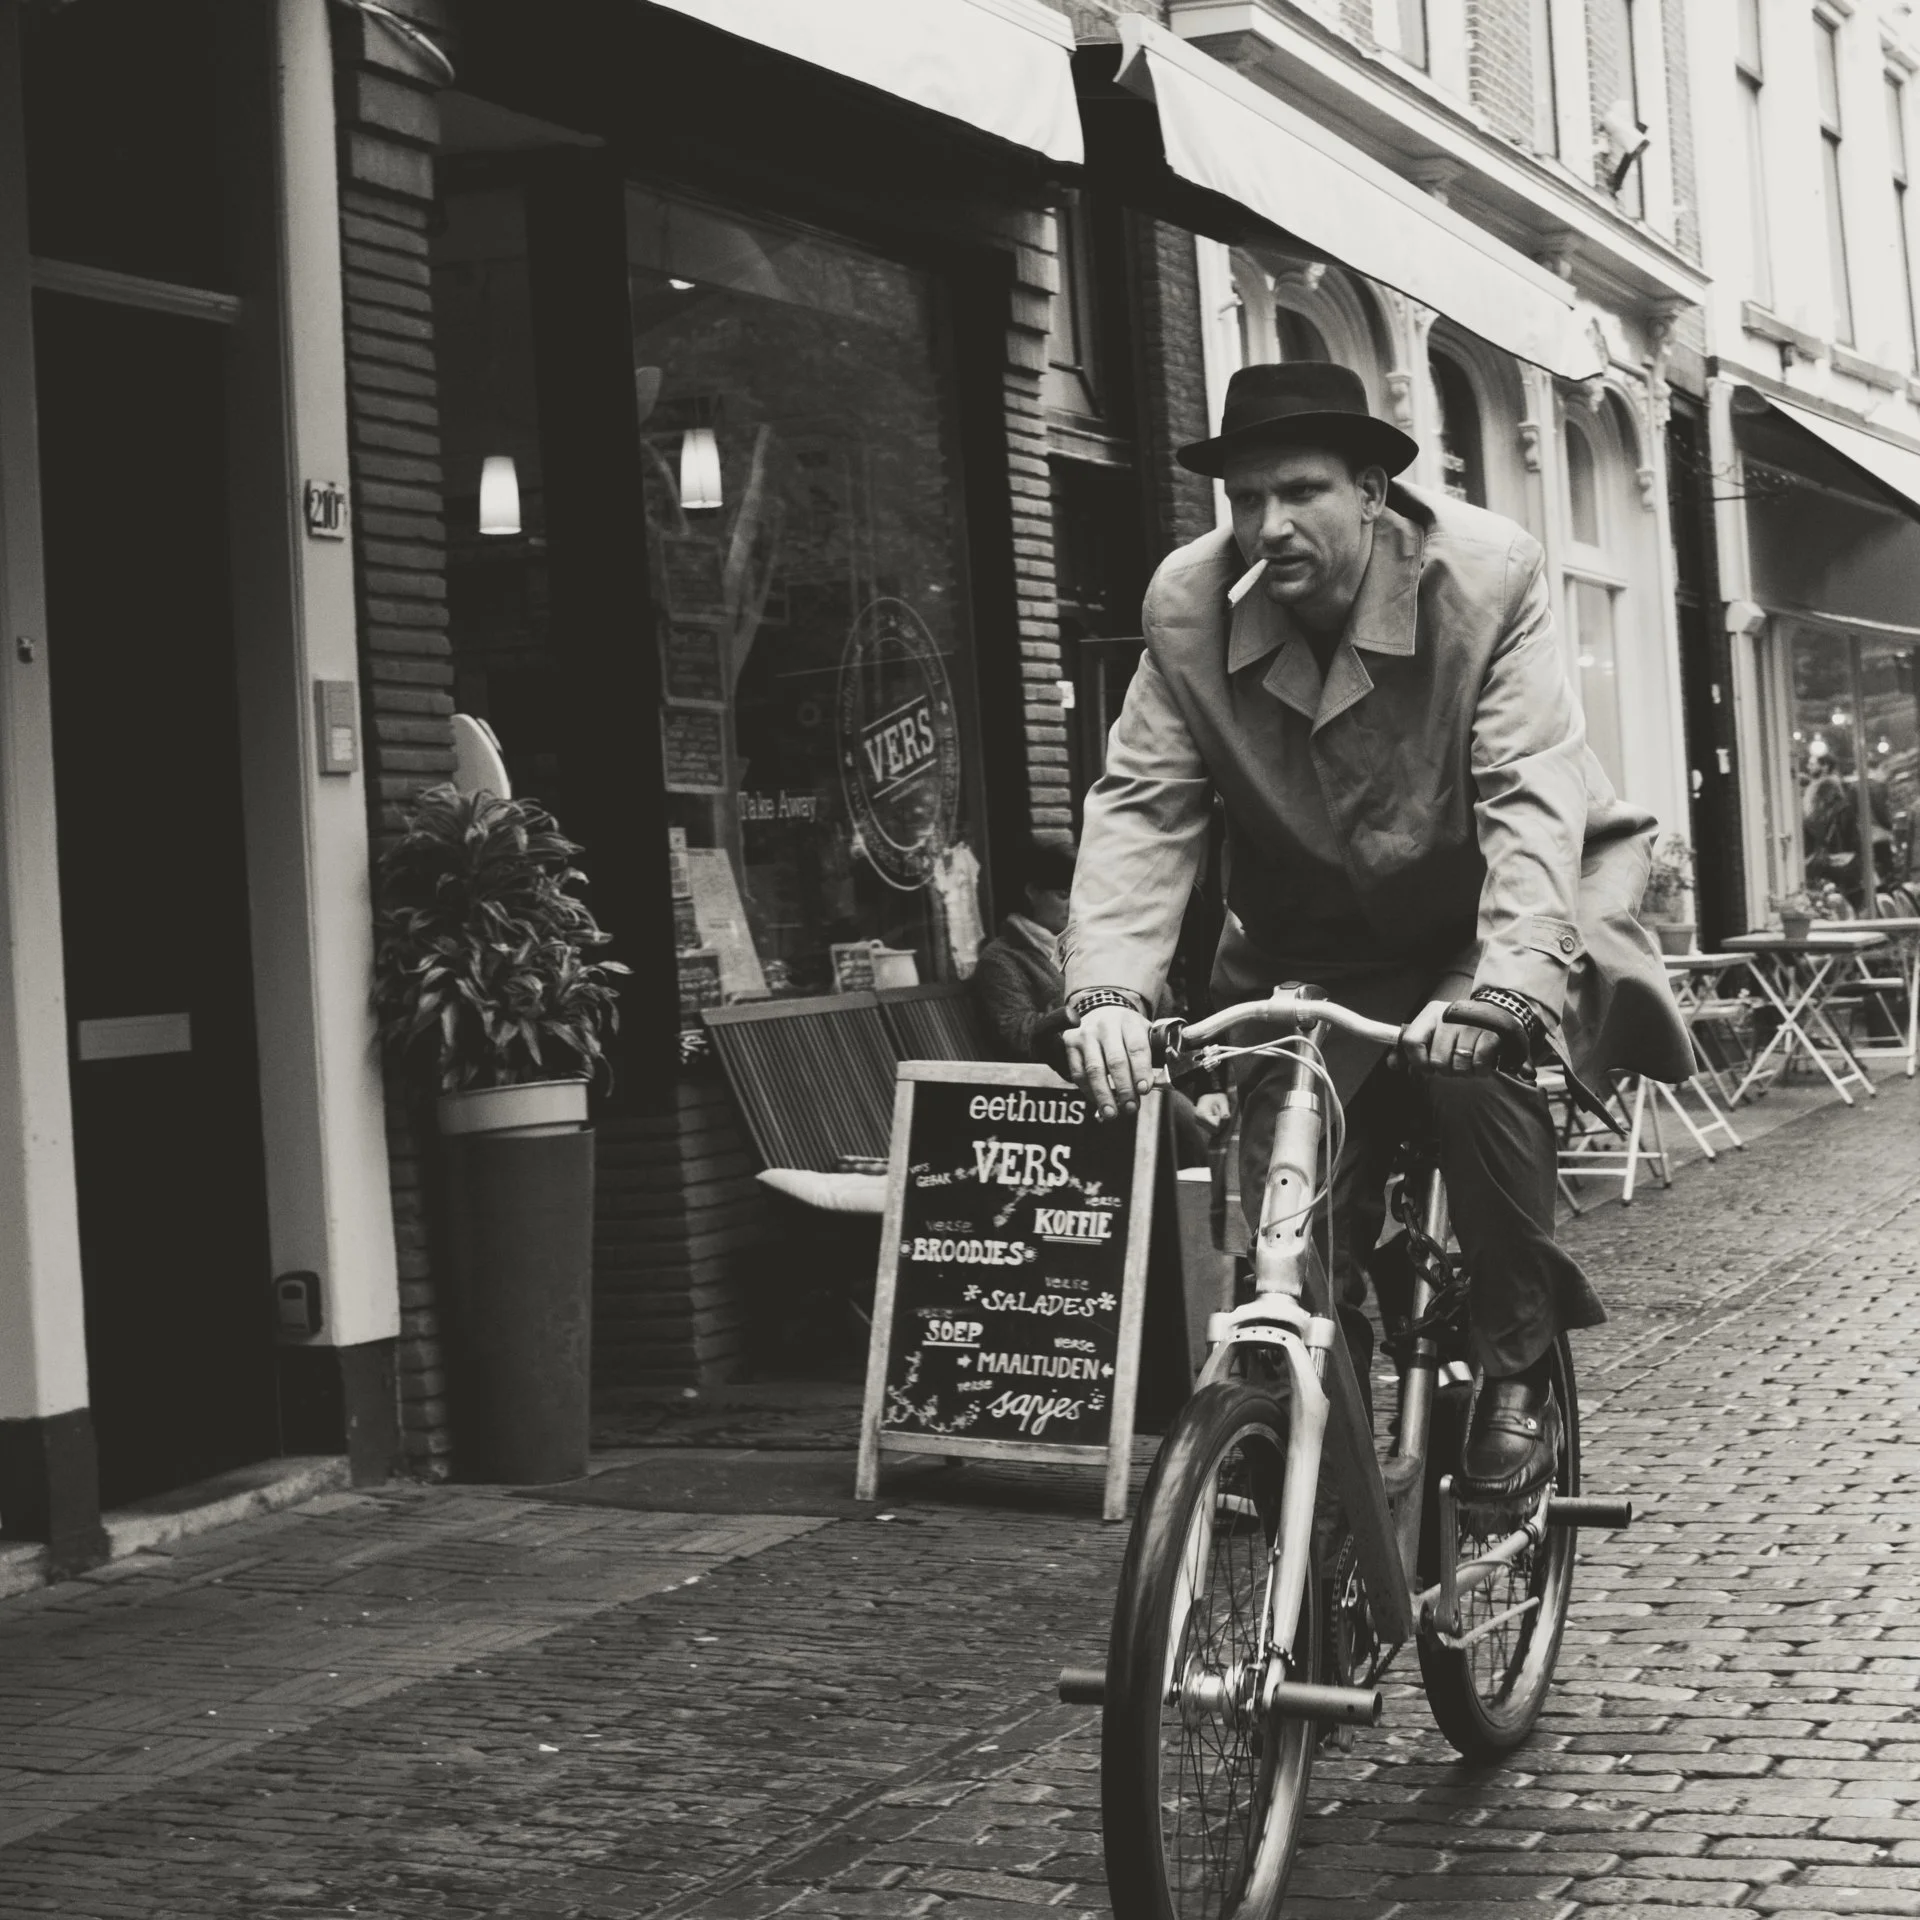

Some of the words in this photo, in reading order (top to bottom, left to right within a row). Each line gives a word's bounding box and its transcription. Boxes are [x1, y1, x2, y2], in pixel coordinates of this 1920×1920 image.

[864, 707, 936, 784] VERS
[737, 790, 775, 820] Take
[777, 789, 817, 824] Away
[969, 1090, 1086, 1125] eethuis
[972, 1140, 1072, 1187] VERS
[1033, 1208, 1113, 1239] KOFFIE
[911, 1237, 1025, 1266] BROODJES
[981, 1289, 1097, 1317] SALADES
[925, 1320, 984, 1342] SOEP
[976, 1352, 1101, 1381] MAALTIJDEN
[986, 1389, 1085, 1435] sapjes
